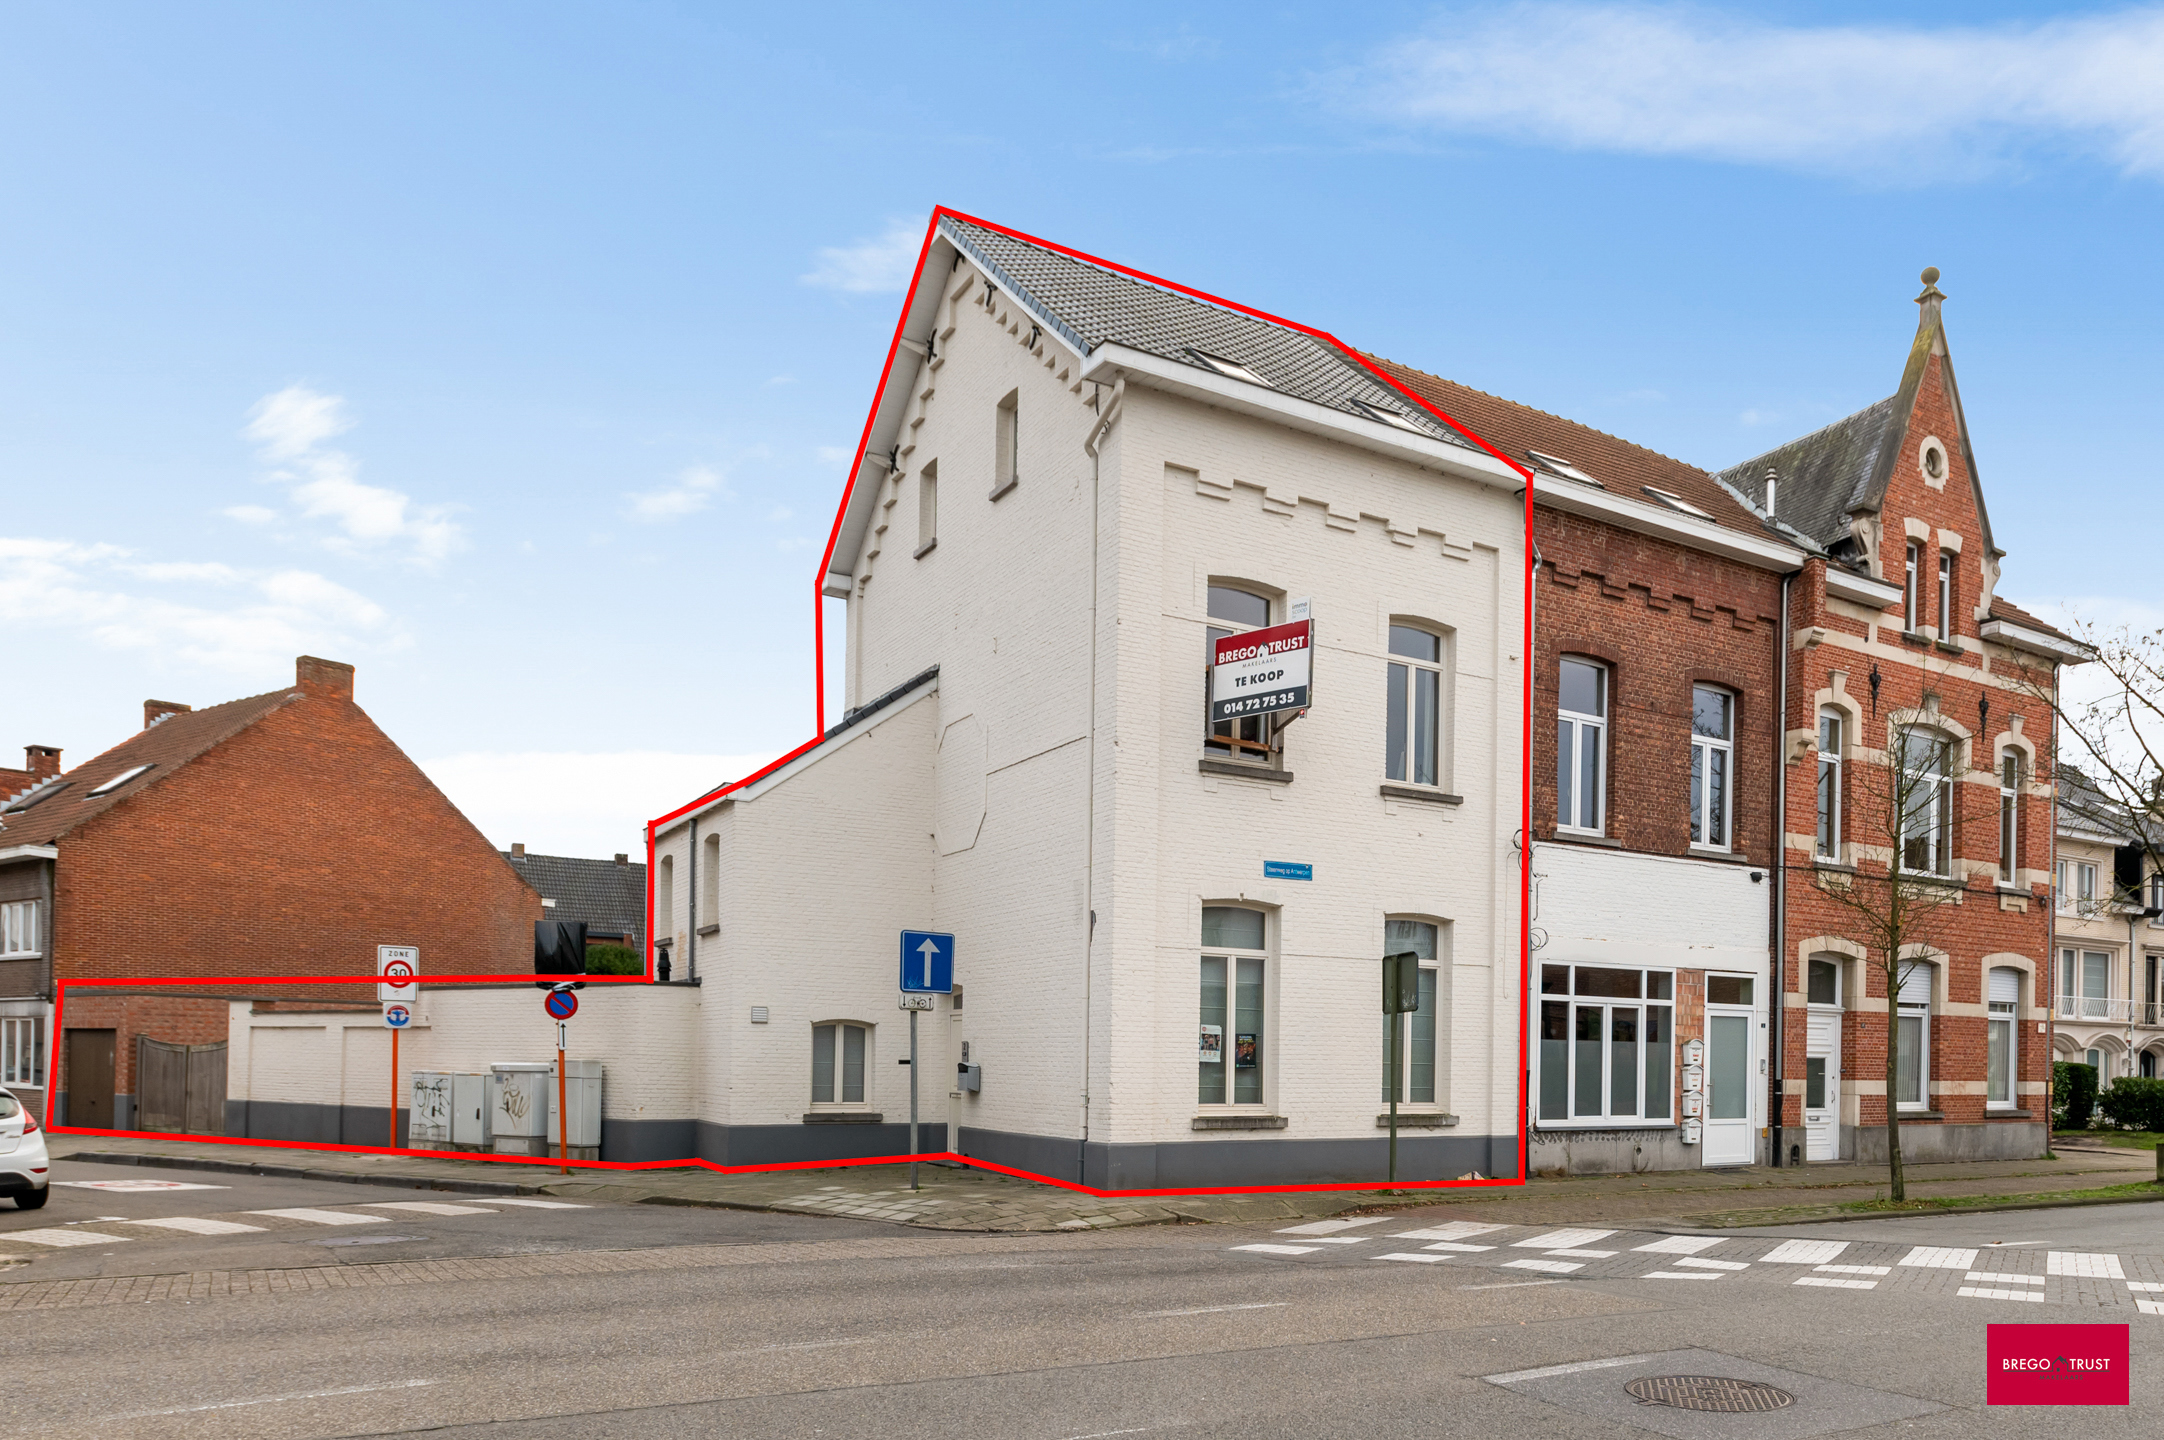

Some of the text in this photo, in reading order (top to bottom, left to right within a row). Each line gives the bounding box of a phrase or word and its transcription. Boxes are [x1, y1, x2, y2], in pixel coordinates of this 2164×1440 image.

[1218, 636, 1305, 664] BREGO TRUST
[1242, 657, 1277, 668] MAKELAARS
[1235, 669, 1284, 688] TE KOOP
[1223, 692, 1295, 714] 014 72 75 35
[1266, 866, 1285, 875] Steenweg
[1291, 868, 1310, 876] Antwerpen
